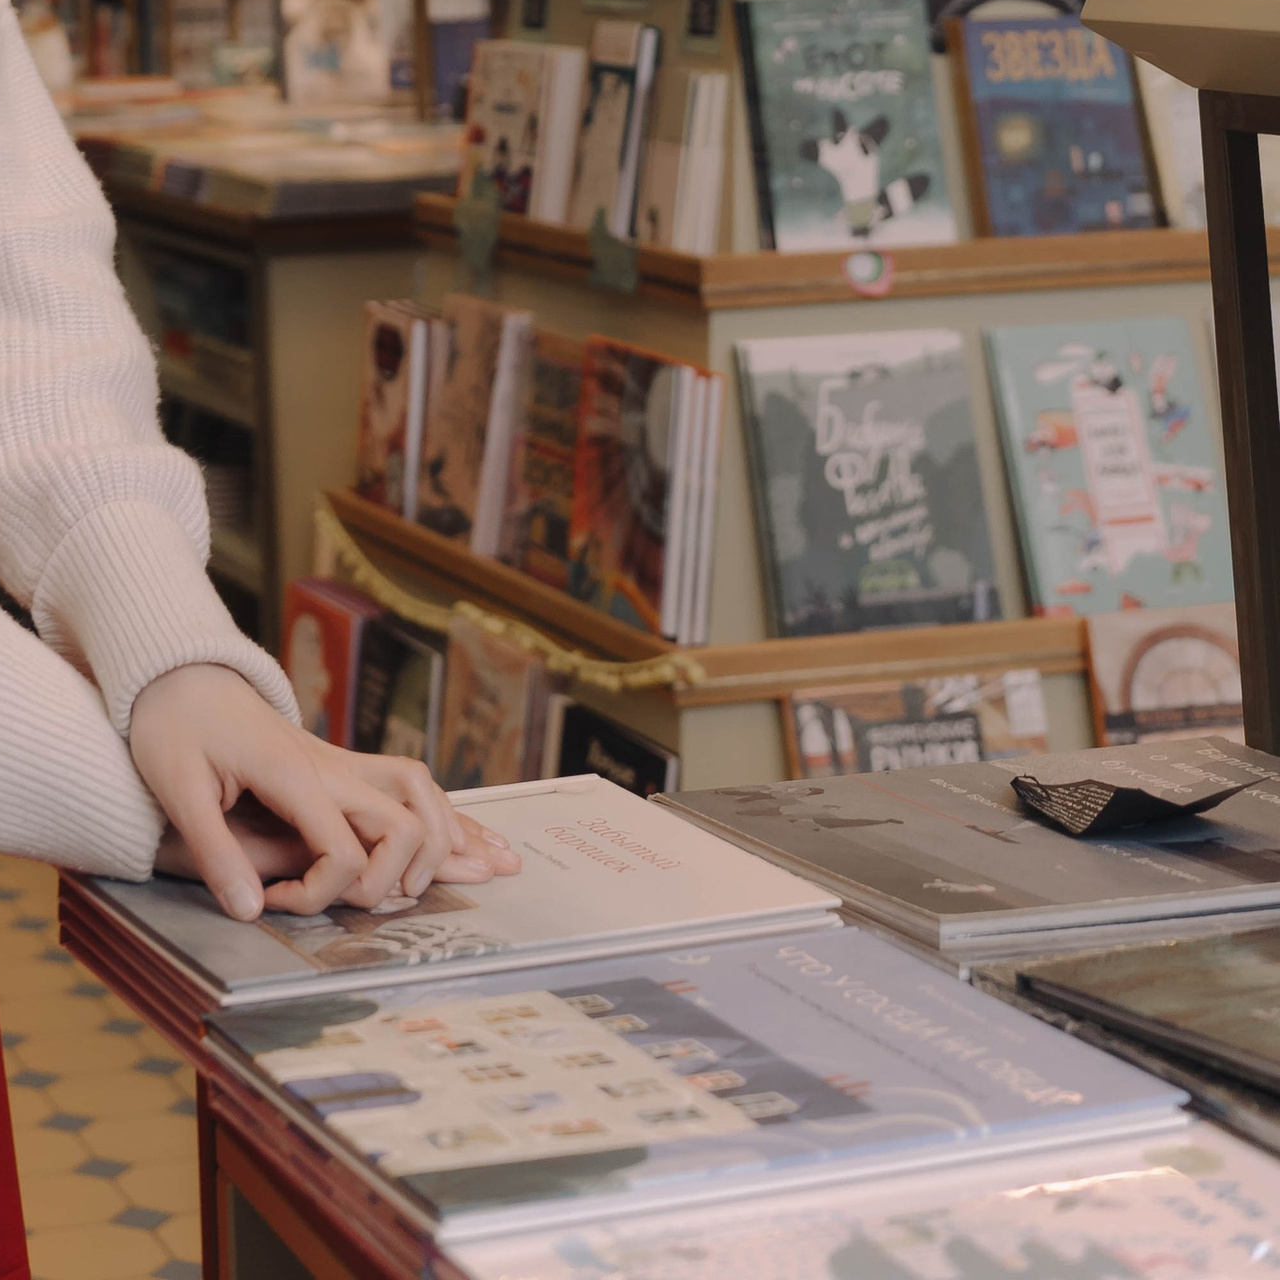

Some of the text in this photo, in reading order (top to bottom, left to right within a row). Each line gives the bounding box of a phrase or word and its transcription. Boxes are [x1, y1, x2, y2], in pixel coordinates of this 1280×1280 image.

[981, 28, 1117, 82] ЗВЕЗДА
[1169, 762, 1280, 803] маленко
[545, 826, 637, 874] барашек
[576, 817, 686, 870] Забытый
